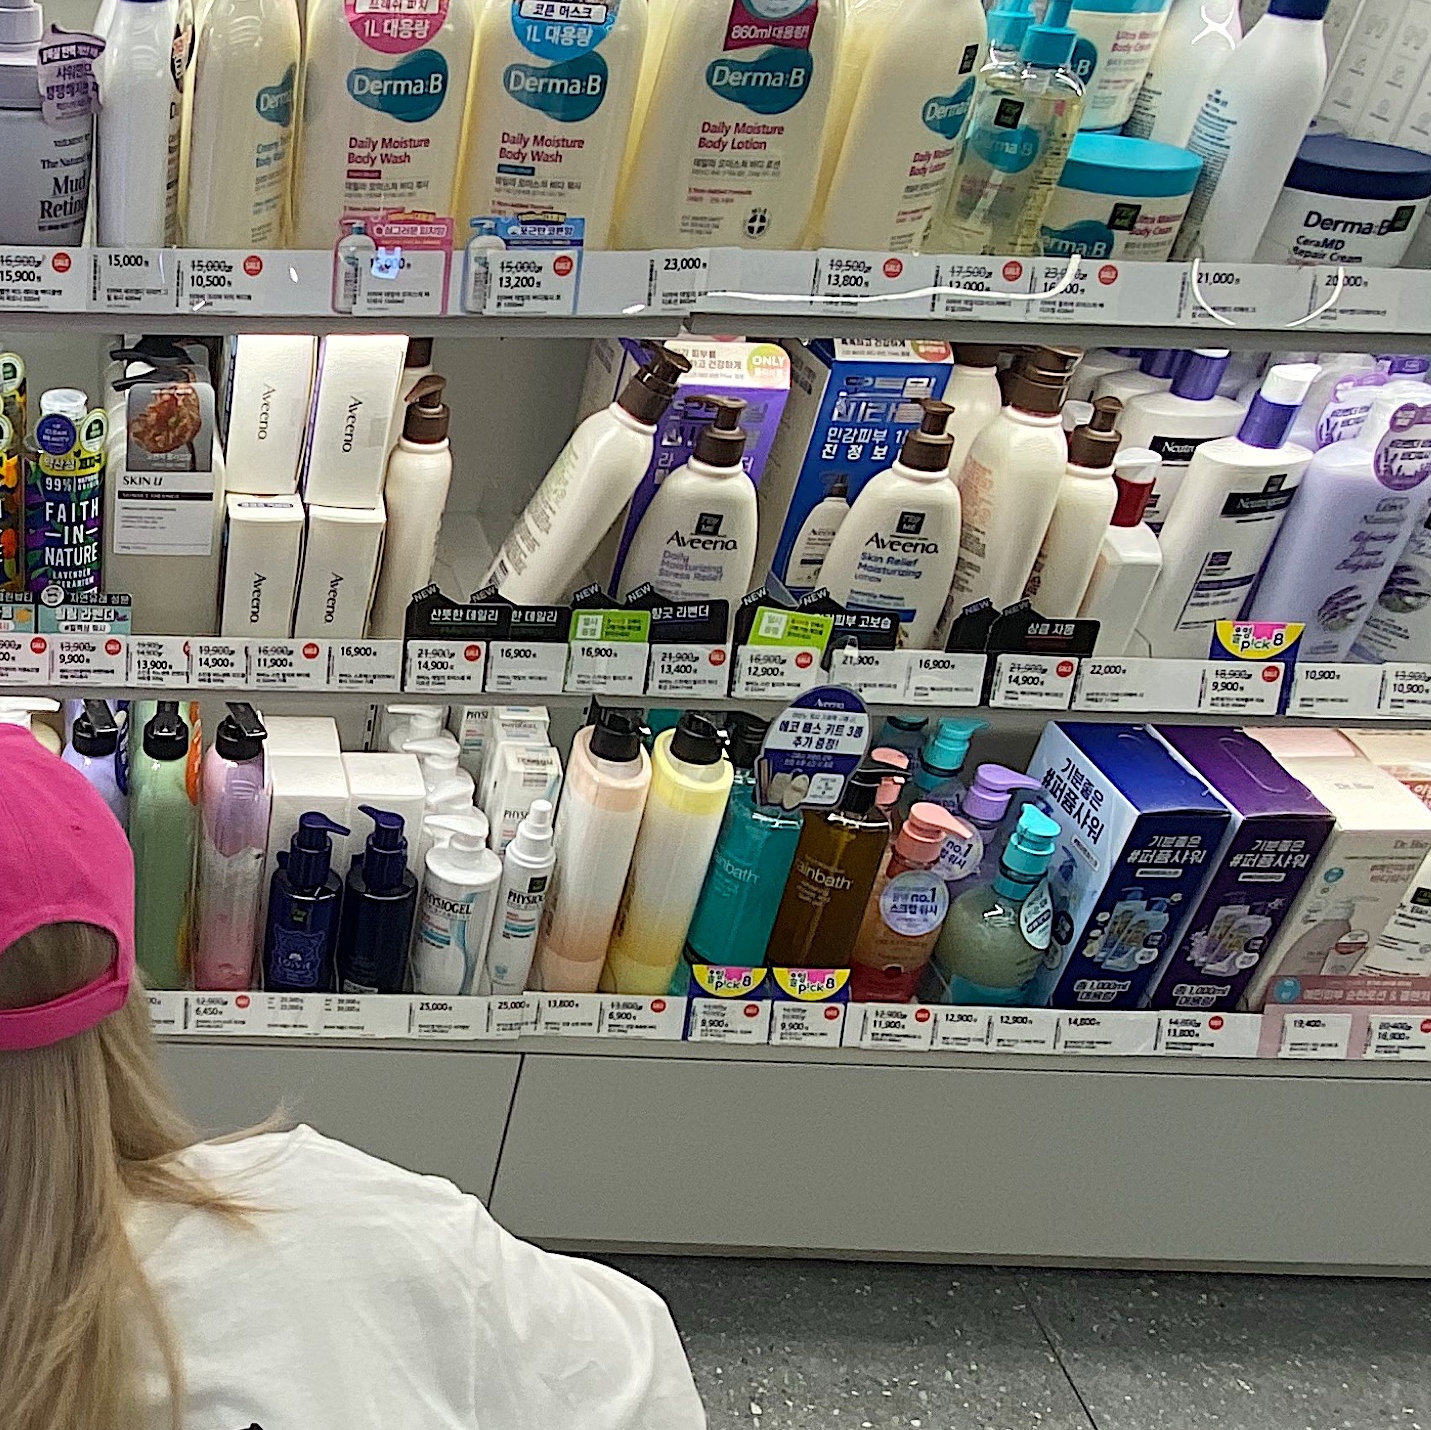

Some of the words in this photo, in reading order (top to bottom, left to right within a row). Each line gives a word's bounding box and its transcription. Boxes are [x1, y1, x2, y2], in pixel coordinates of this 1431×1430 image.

[559, 5, 593, 18] 머스크
[363, 20, 380, 37] 1L
[383, 18, 430, 39] 대용량
[525, 26, 541, 43] 1L
[544, 24, 594, 47] 대용량
[731, 25, 770, 39] 860ml
[352, 73, 443, 96] Derma:B
[508, 71, 602, 95] Derma:B
[712, 65, 805, 88] Derma:B
[701, 122, 731, 137] Daily
[733, 122, 785, 136] Moisture
[349, 137, 378, 152] Daily
[381, 137, 430, 149] Moisture
[501, 132, 530, 149] Daily
[532, 134, 585, 149] Moisture
[698, 137, 728, 152] Body
[730, 138, 767, 151] Lotion
[348, 152, 376, 167] Body
[380, 152, 411, 164] Wash
[499, 148, 529, 164] Body
[530, 150, 563, 163] Wash
[53, 174, 86, 195] Mud
[1304, 210, 1392, 236] Derma:B
[752, 355, 785, 367] ONLY
[257, 383, 277, 440] Aveeno
[342, 396, 363, 453] Aveeno
[827, 427, 887, 445] 민감피부
[45, 477, 72, 491] 99%
[122, 476, 151, 486] SKIN
[45, 496, 99, 522] FAITH
[63, 525, 84, 545] IN
[667, 530, 738, 551] Aveeno
[865, 532, 939, 555] Aveeno
[45, 542, 98, 567] NATURE
[663, 550, 689, 563] Daily
[861, 553, 882, 563] Skin
[886, 556, 919, 567] Relief
[661, 560, 723, 574] Moisturizing
[857, 562, 922, 578] Moisturizing
[250, 572, 267, 624] Aveeno
[324, 572, 344, 624] Aveeno
[413, 585, 438, 603] NEW
[472, 586, 497, 602] NEW
[575, 584, 600, 602] NEW
[626, 584, 652, 602] NEW
[803, 588, 828, 606] NEW
[466, 609, 498, 623] 데일리
[525, 610, 558, 623] 데일리
[1273, 632, 1284, 646] 8
[742, 975, 752, 987] 8
[825, 977, 835, 990] 8
